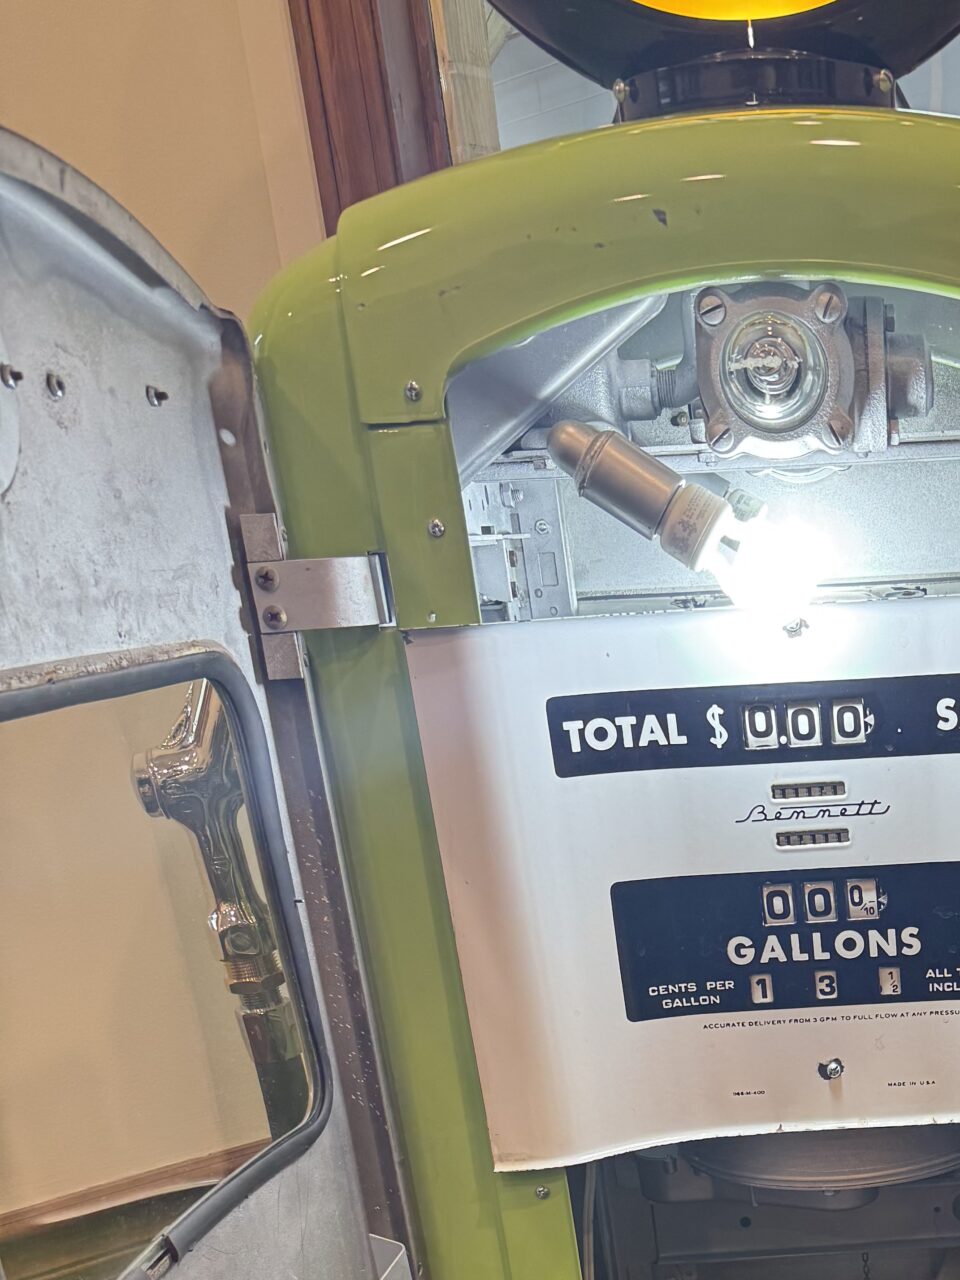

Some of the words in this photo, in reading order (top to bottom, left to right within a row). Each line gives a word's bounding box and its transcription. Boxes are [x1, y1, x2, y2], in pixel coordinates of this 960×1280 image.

[562, 713, 688, 753] TOTAL
[706, 704, 729, 749] $
[735, 799, 891, 824] Bennett
[727, 926, 922, 966] GALLONS
[925, 968, 952, 978] ALL
[648, 982, 697, 996] CENTS
[706, 980, 735, 991] PER
[755, 978, 768, 999] 1
[818, 975, 836, 996] 3
[662, 995, 721, 1009] GALLON
[703, 1021, 746, 1030] ACCURATE
[748, 1019, 787, 1027] DELIVERY
